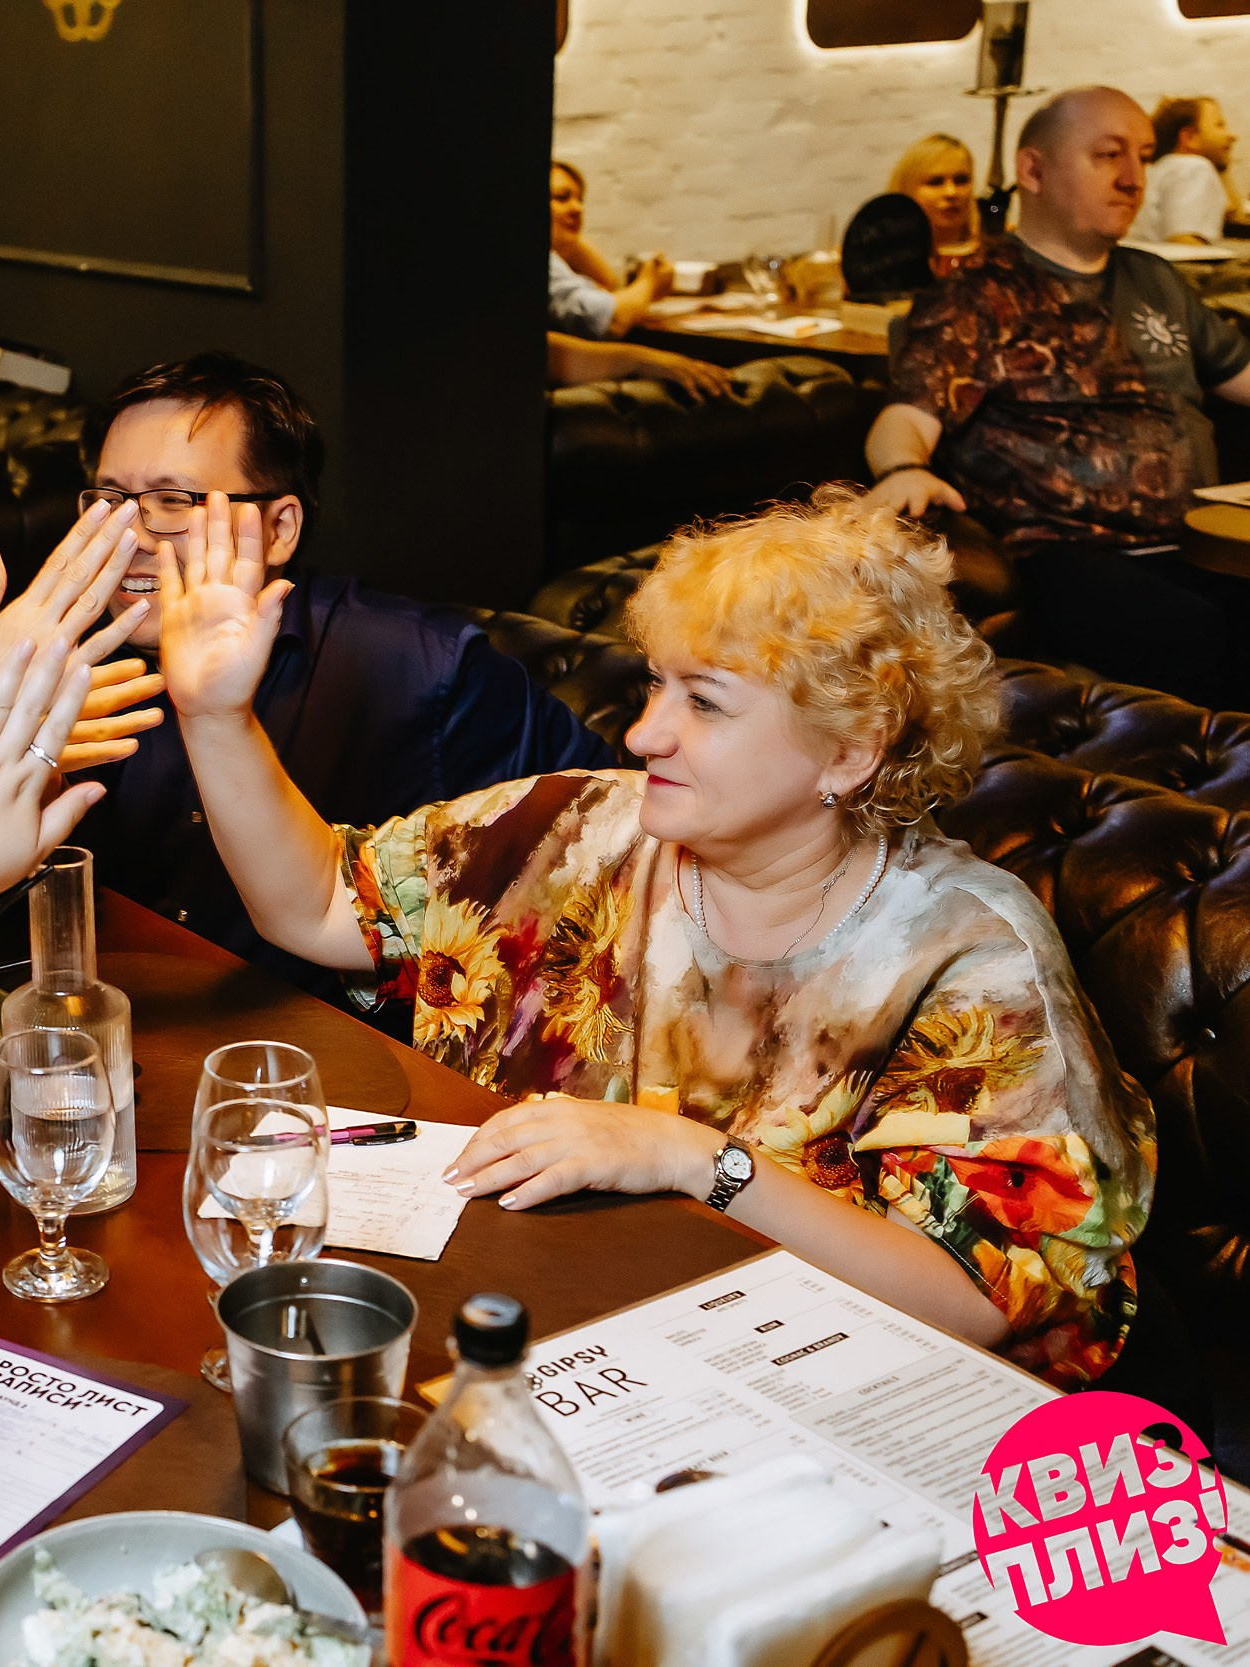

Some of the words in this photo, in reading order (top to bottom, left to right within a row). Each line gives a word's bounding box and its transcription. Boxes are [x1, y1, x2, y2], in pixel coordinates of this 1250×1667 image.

[536, 1345, 609, 1378] GIPSY
[78, 1388, 149, 1418] ЛИСТ
[534, 1368, 649, 1417] BAR
